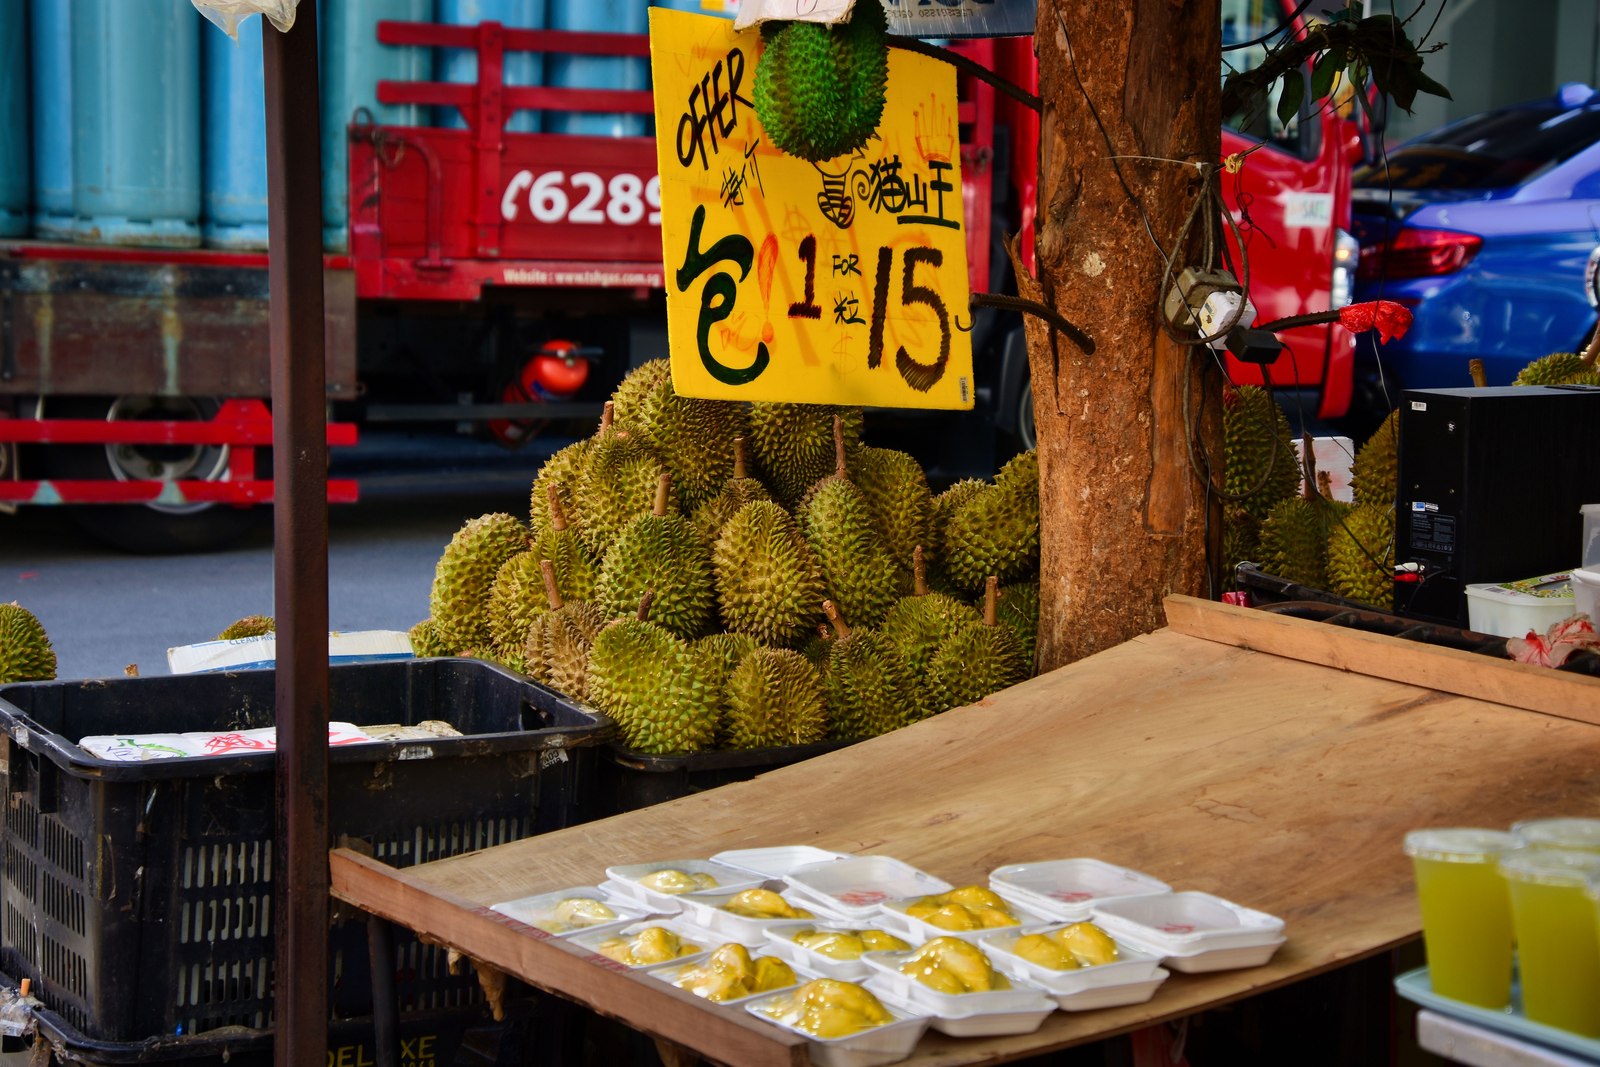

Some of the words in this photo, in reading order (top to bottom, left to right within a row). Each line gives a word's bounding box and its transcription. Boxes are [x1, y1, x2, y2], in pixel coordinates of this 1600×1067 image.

[676, 48, 756, 171] OFFER
[869, 154, 960, 231] 猫山王
[503, 267, 547, 285] Website
[787, 233, 822, 321] 1
[832, 254, 862, 280] FOR
[867, 246, 952, 394] 15
[833, 290, 866, 326] 粒
